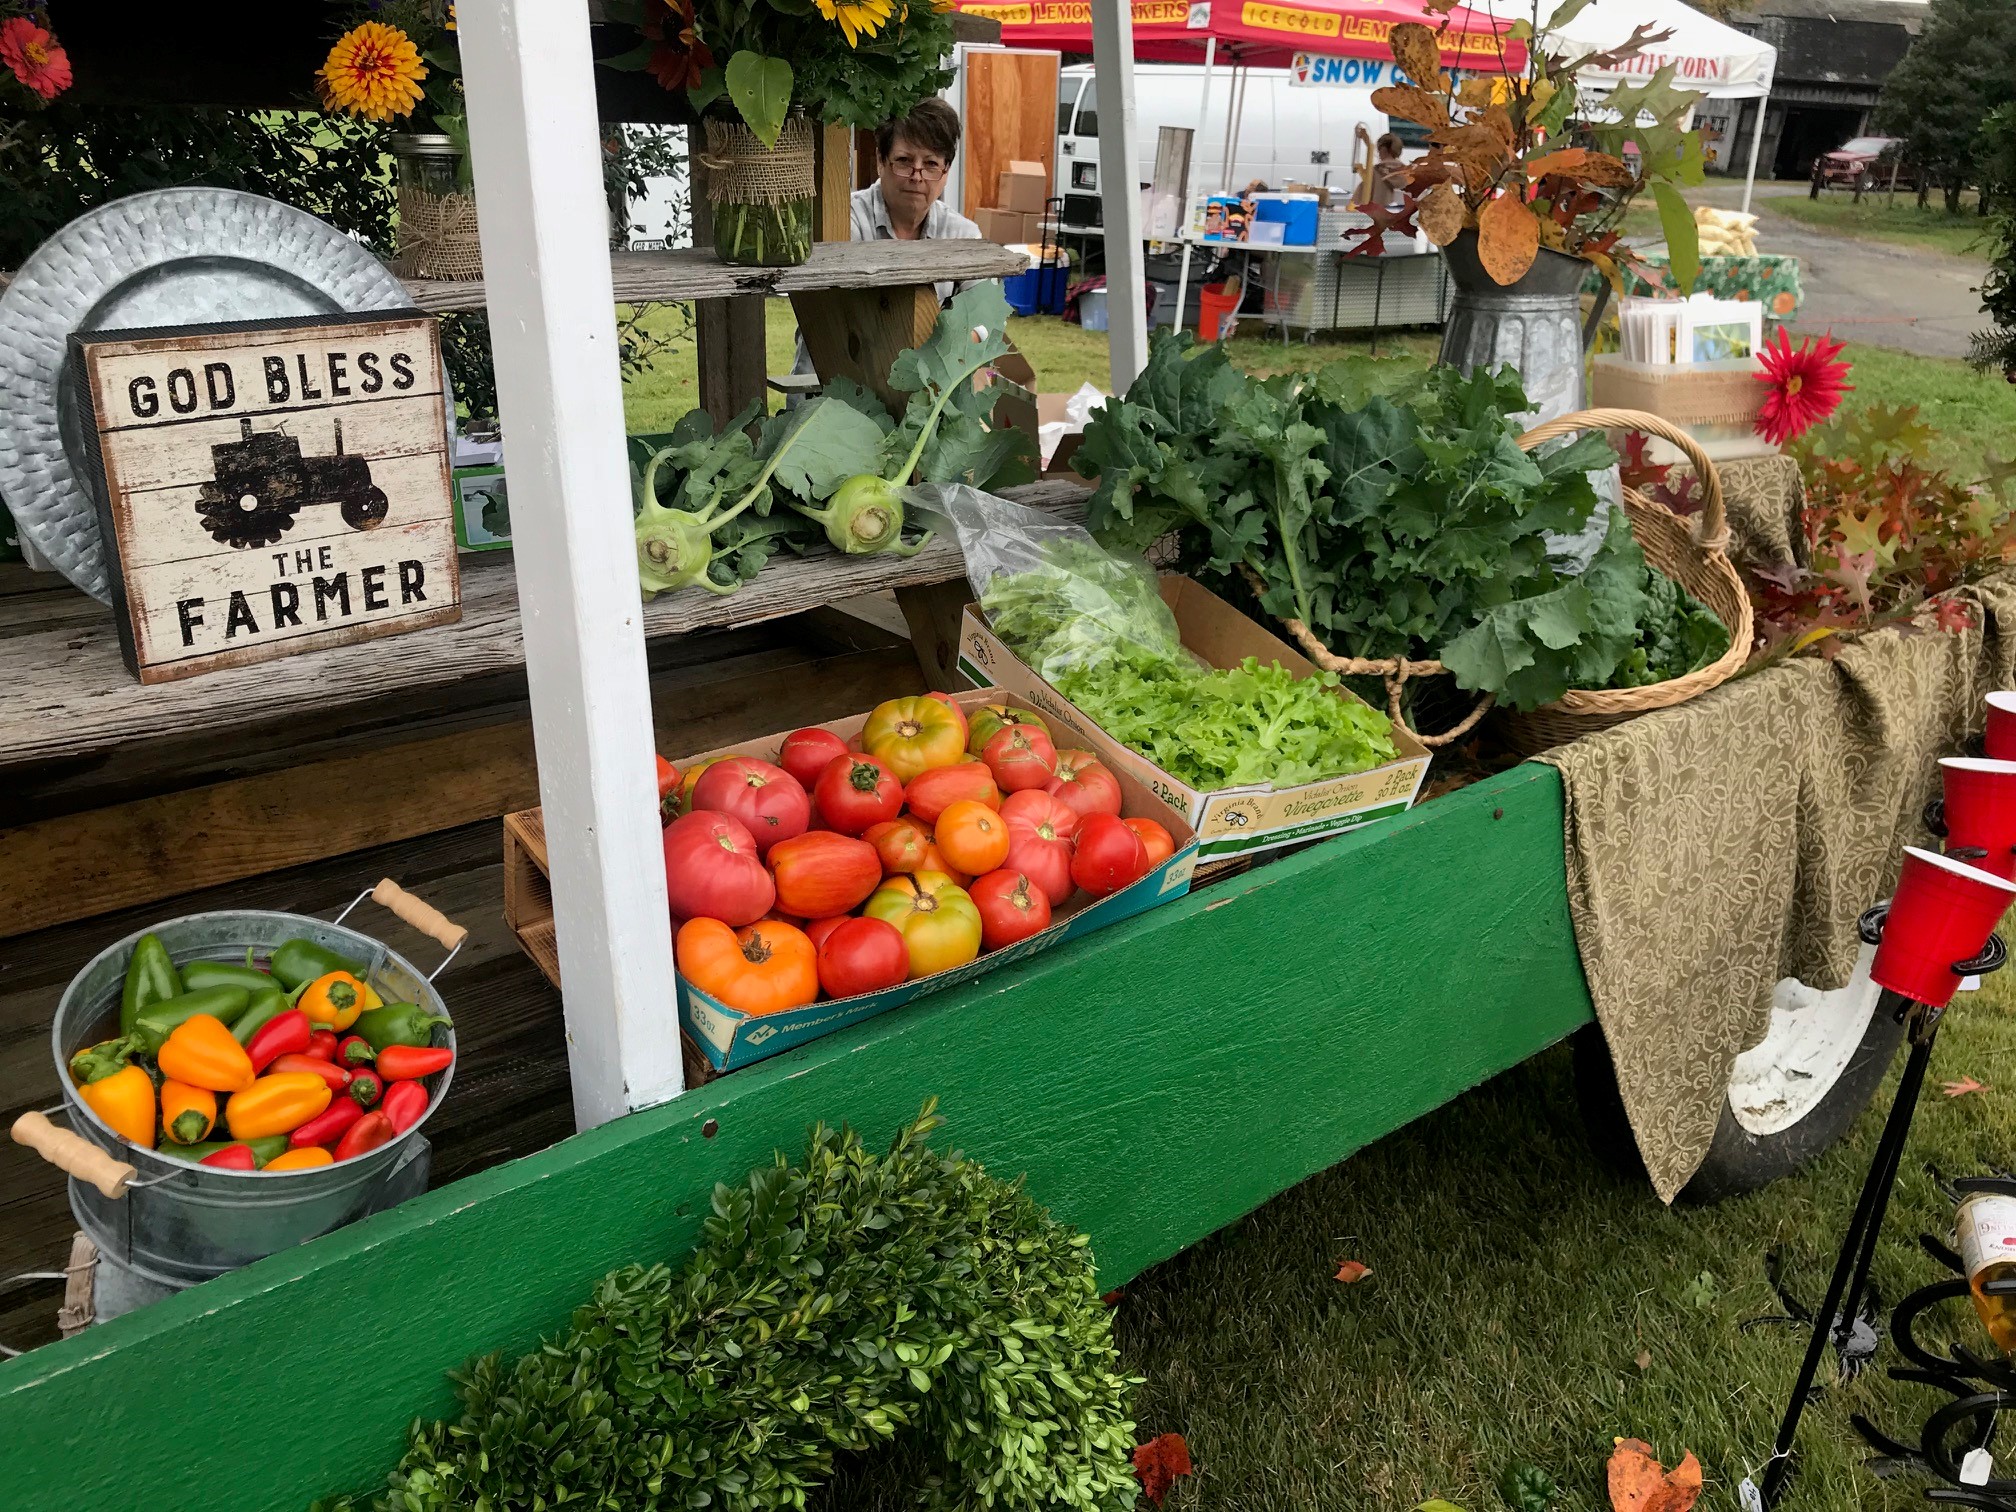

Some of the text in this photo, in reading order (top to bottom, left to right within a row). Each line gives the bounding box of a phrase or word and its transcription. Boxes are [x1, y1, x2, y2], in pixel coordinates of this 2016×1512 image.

[991, 9, 1027, 19] COLD
[1249, 8, 1280, 24] ICE
[1287, 13, 1334, 30] COLD
[1345, 17, 1388, 38] LEM
[1312, 58, 1383, 83] SNOW
[128, 352, 415, 418] GOD BLESS
[272, 545, 333, 577] THE
[176, 559, 428, 647] FARMER
[1332, 783, 1358, 795] Onion
[1385, 764, 1418, 786] 2 Pack
[1152, 780, 1188, 813] 2 Pack
[1374, 786, 1389, 801] 30
[1211, 799, 1245, 823] Virginia
[1246, 797, 1264, 820] Brand
[1262, 830, 1291, 843] Dressing
[1295, 823, 1325, 836] Marinade
[1330, 817, 1350, 829] Veggie
[1350, 814, 1363, 823] Dip
[781, 1001, 878, 1034] Member's Mark
